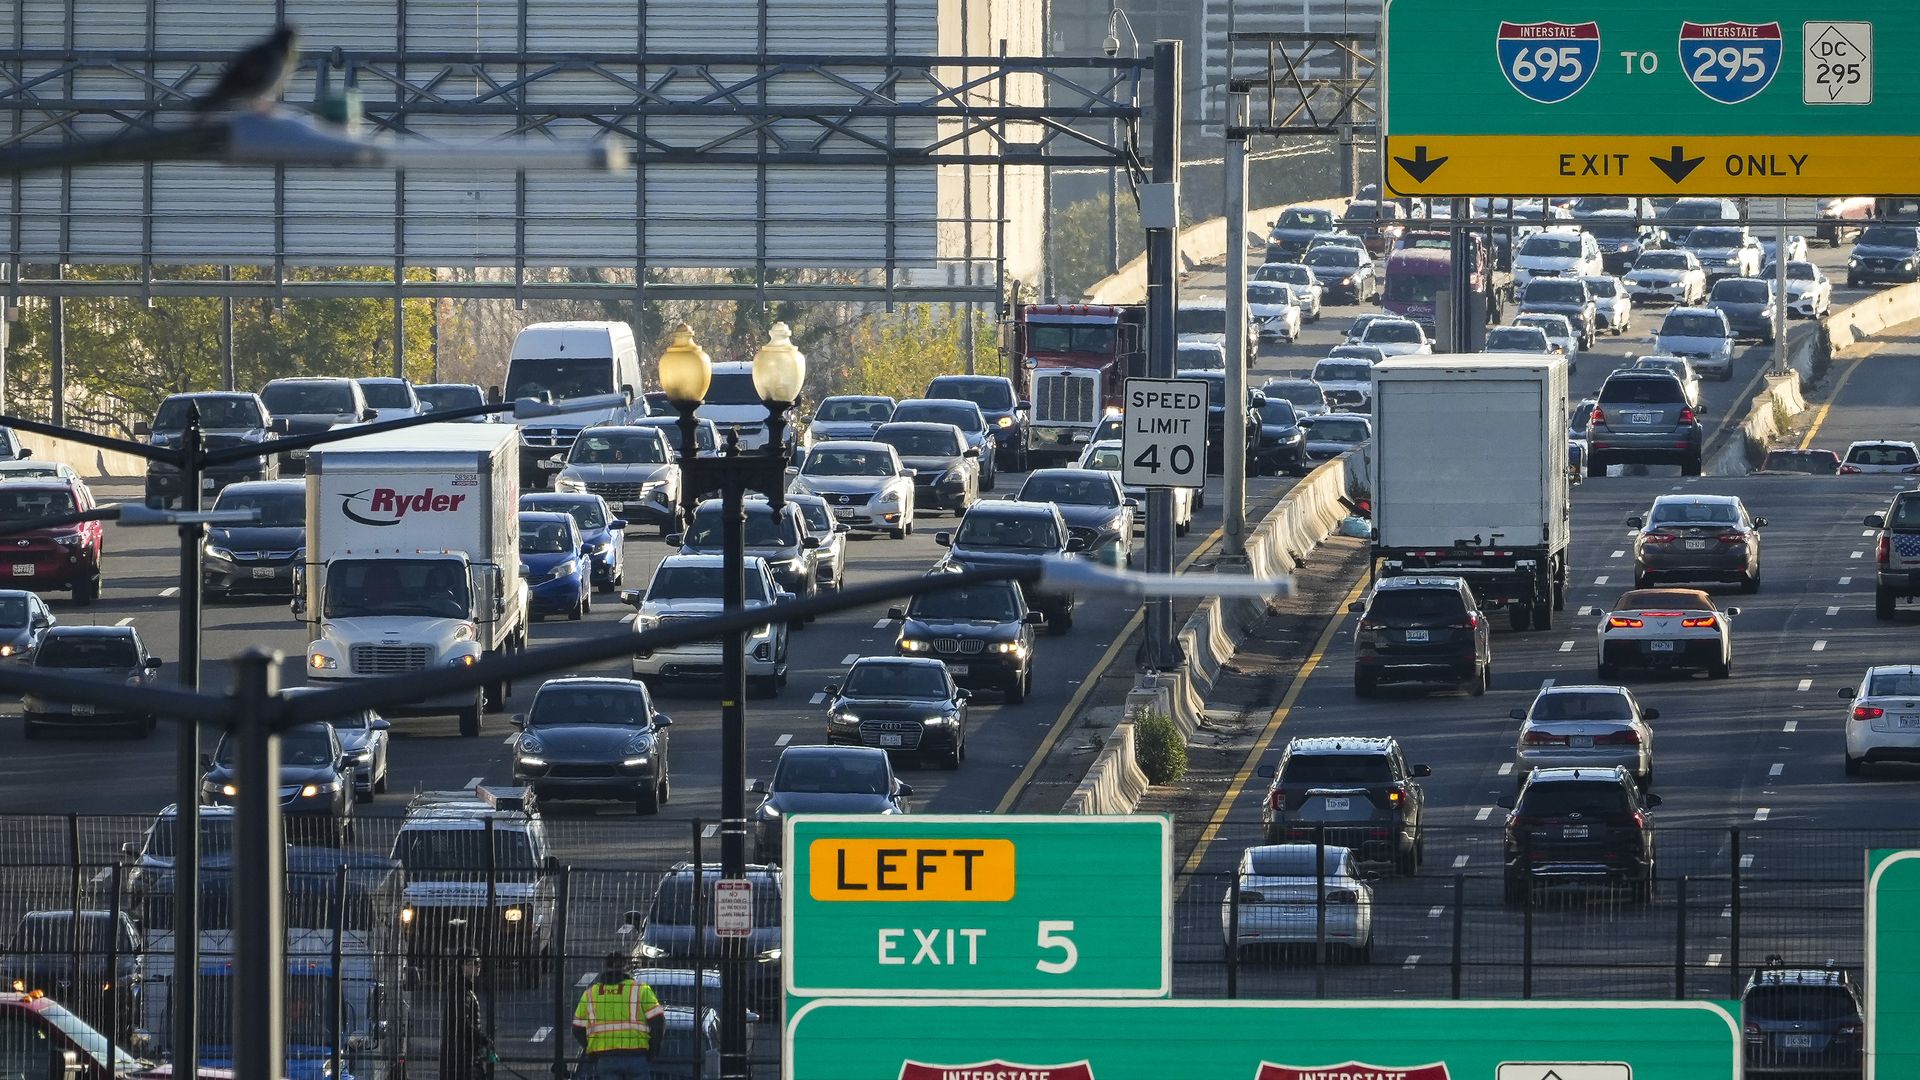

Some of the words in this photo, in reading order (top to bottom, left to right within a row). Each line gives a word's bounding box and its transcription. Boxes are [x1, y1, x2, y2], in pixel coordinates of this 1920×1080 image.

[1520, 27, 1576, 37] INTERSTATE
[1702, 27, 1758, 37] INTERSTATE
[1821, 41, 1847, 57] DC
[1512, 47, 1582, 82] 695
[1620, 51, 1658, 74] TO
[1693, 47, 1766, 82] 295
[1816, 63, 1861, 84] 295
[1559, 154, 1629, 176] EXIT
[1725, 154, 1808, 176] ONLY
[1132, 391, 1200, 409] SPEED
[1137, 417, 1191, 434] LIMIT
[1133, 444, 1195, 475] 40
[371, 488, 465, 518] Ryder
[837, 848, 984, 891] LEFT
[878, 928, 987, 965] EXIT
[1035, 920, 1079, 974] 5
